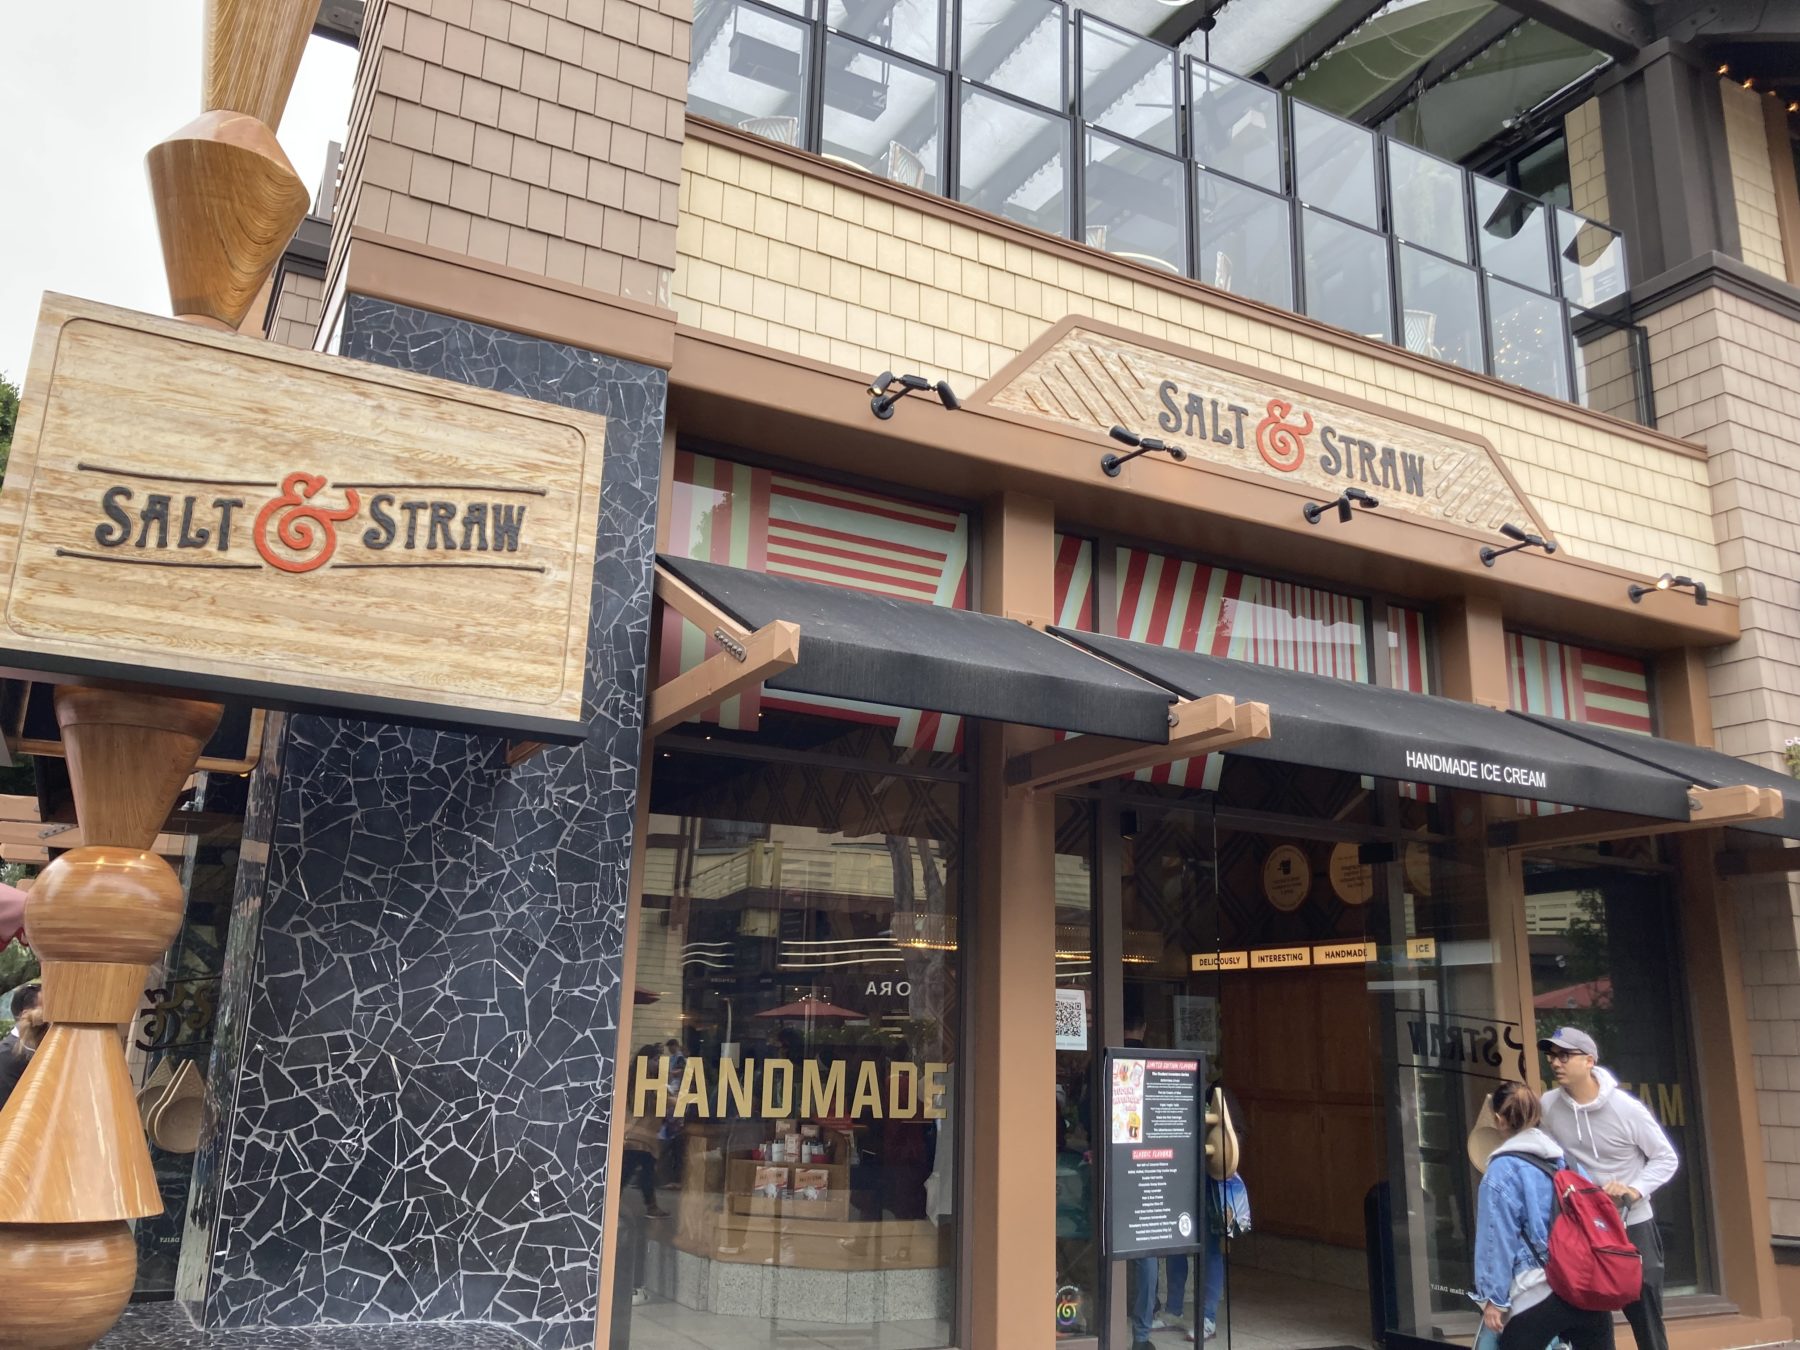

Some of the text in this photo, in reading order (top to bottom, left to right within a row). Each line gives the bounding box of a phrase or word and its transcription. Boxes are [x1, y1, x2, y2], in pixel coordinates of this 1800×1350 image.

[1158, 380, 1425, 497] SALT & STRAW
[94, 471, 526, 574] SALT & STRAW
[1406, 750, 1547, 788] HANDMADE ICE CREAM
[1257, 953, 1303, 964] INTERESTING
[1324, 948, 1368, 959] HANDMADE
[1415, 943, 1430, 954] ICE
[633, 1055, 949, 1120] HANDMADE
